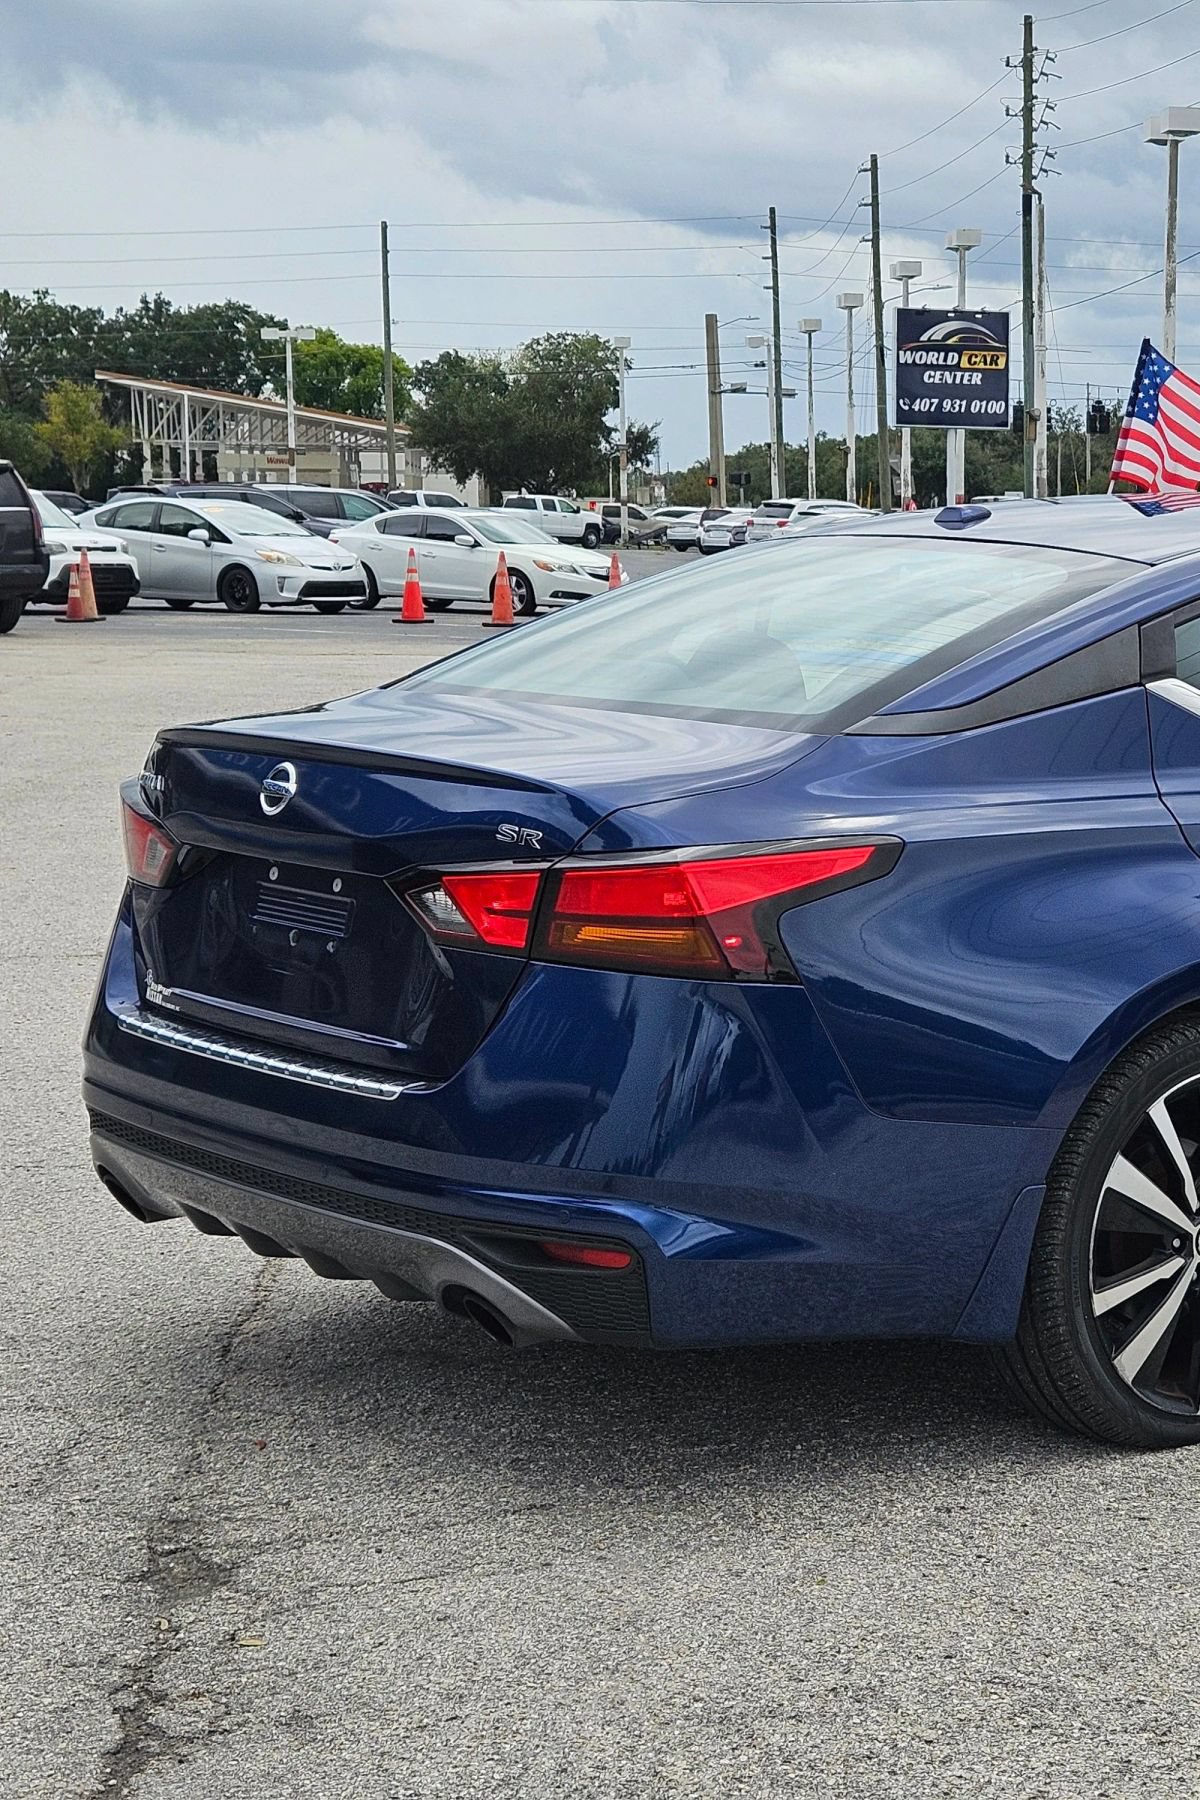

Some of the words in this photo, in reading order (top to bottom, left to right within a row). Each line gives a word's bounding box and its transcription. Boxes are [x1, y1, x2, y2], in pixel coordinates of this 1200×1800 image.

[899, 350, 959, 365] WORLD
[967, 353, 1000, 367] CAR
[923, 371, 982, 385] CENTER
[911, 398, 939, 412] 407
[942, 400, 966, 413] 931
[970, 400, 1006, 414] 0100
[495, 823, 543, 850] SR
